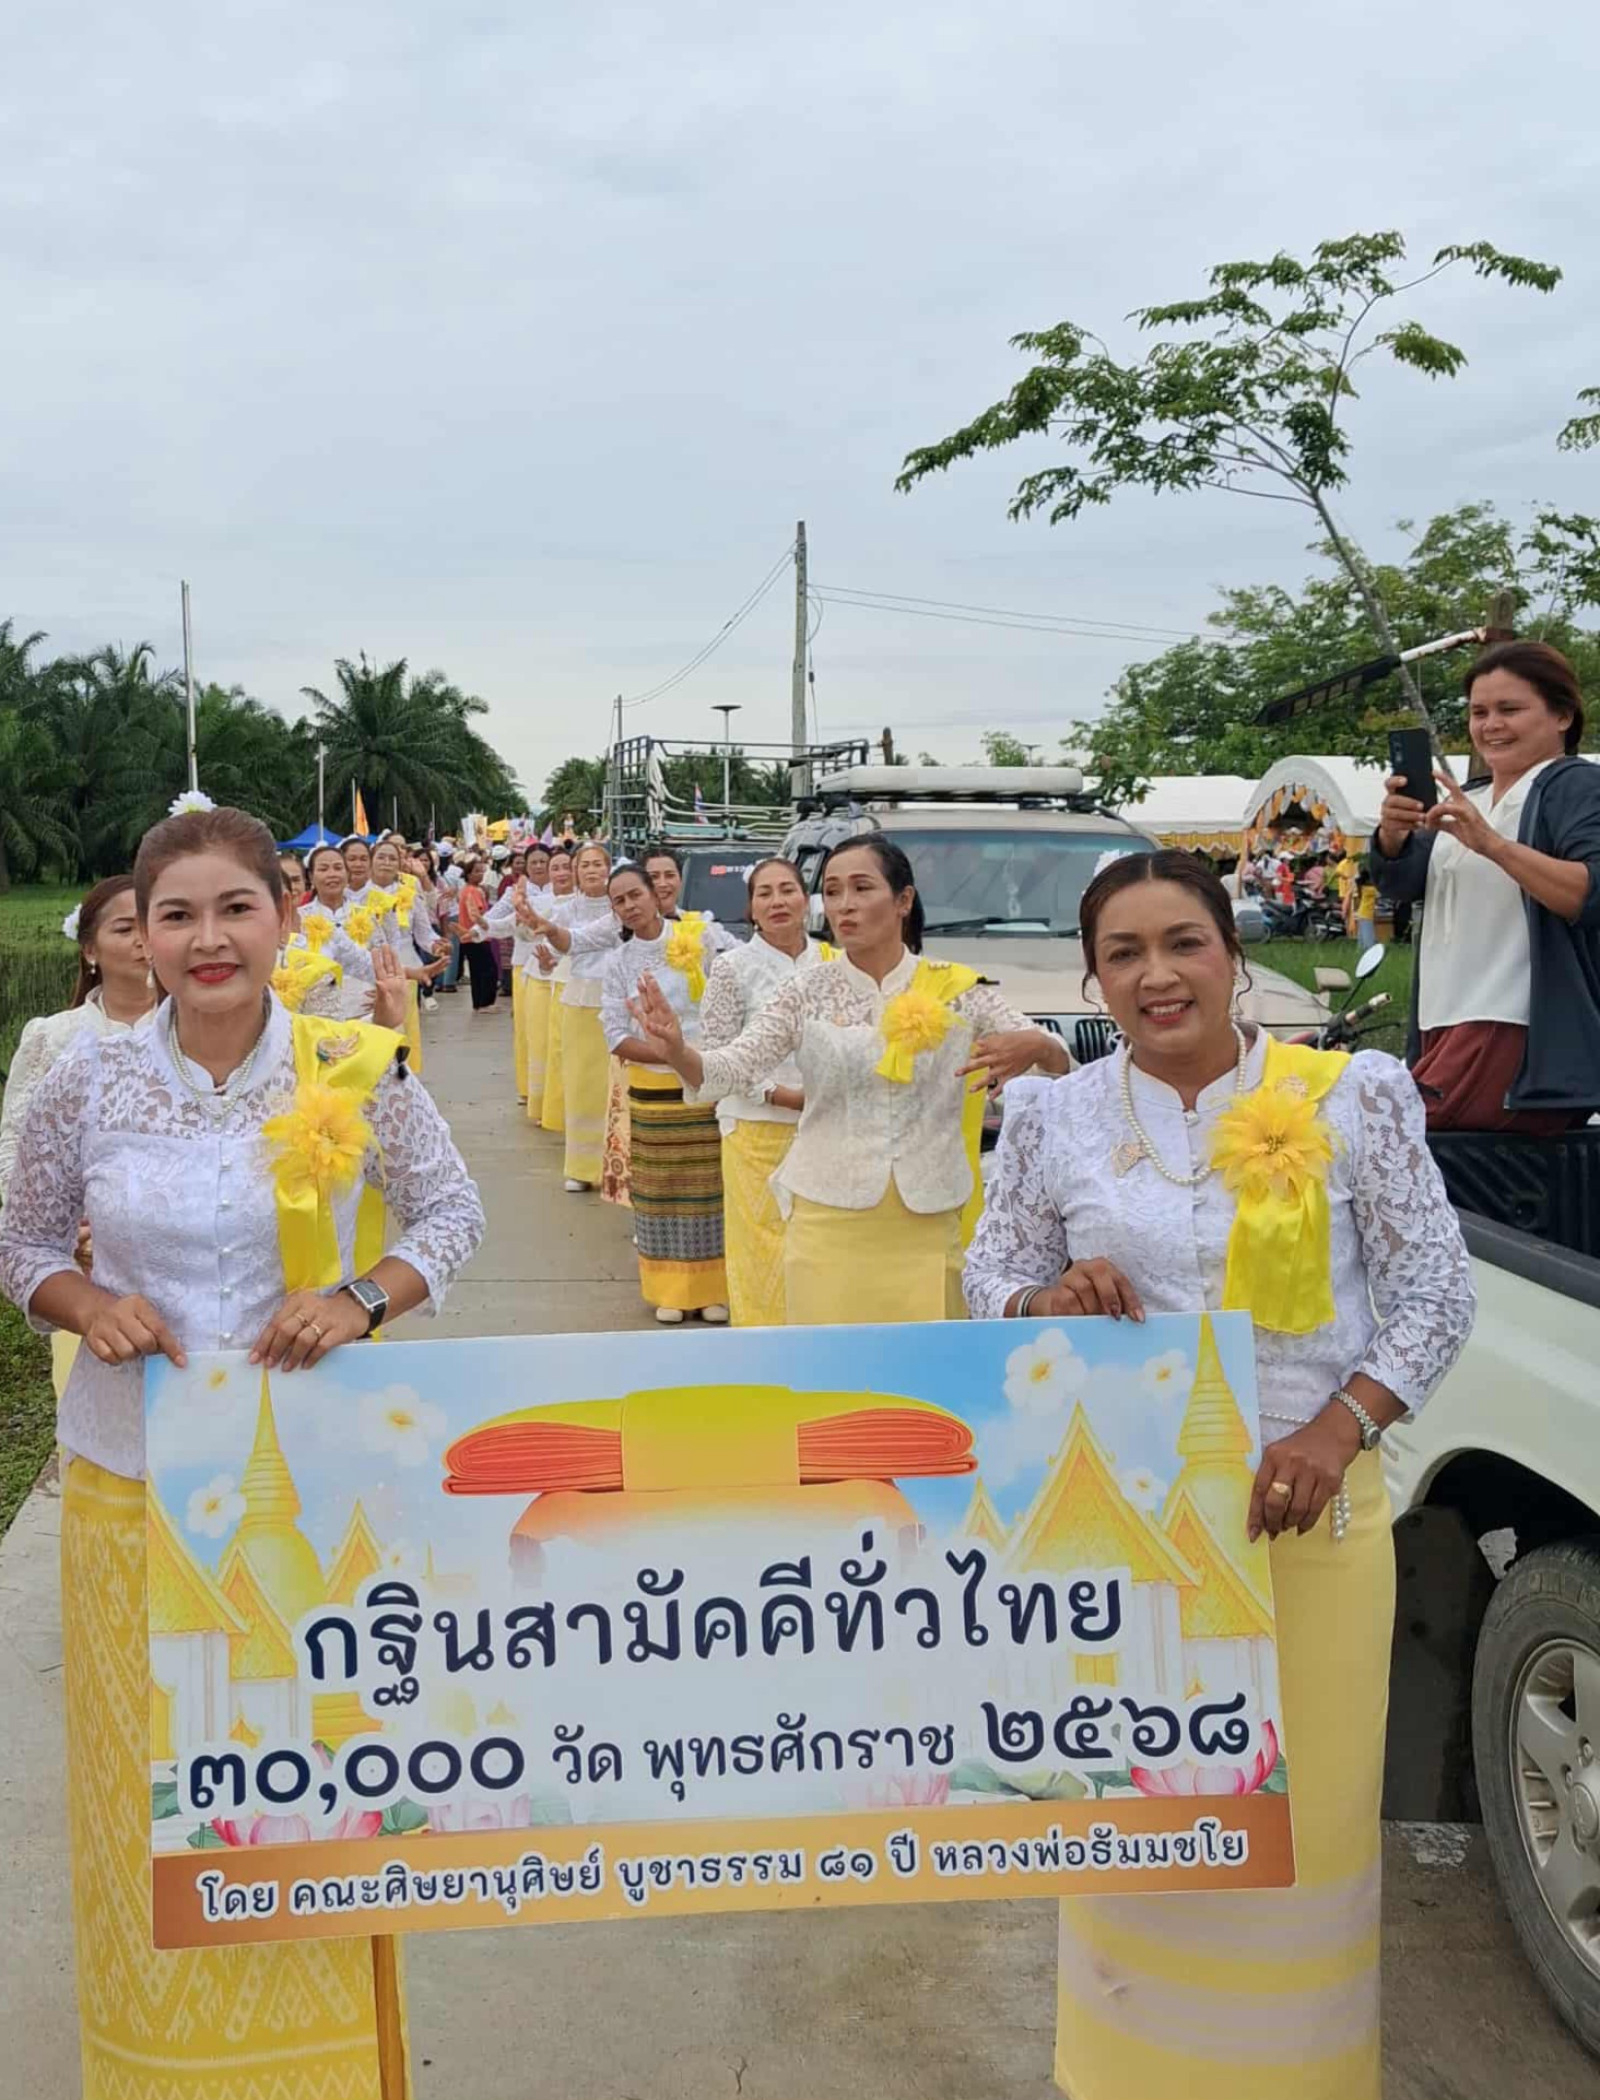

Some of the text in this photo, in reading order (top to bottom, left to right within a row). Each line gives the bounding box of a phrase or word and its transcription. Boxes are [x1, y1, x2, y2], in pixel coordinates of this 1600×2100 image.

[303, 1530, 1121, 1707] กฐินสามัคคีทั่วไทย
[188, 1692, 1251, 1815] ๓๐,๐๐๐ วัด พุทธศักราช ๒๕๖๘
[200, 1822, 1245, 1916] โดย คณะศิษยานุศิษย์ บูชาธรรม ๘๑ ปี หลวงพ่อธัมมชโย
